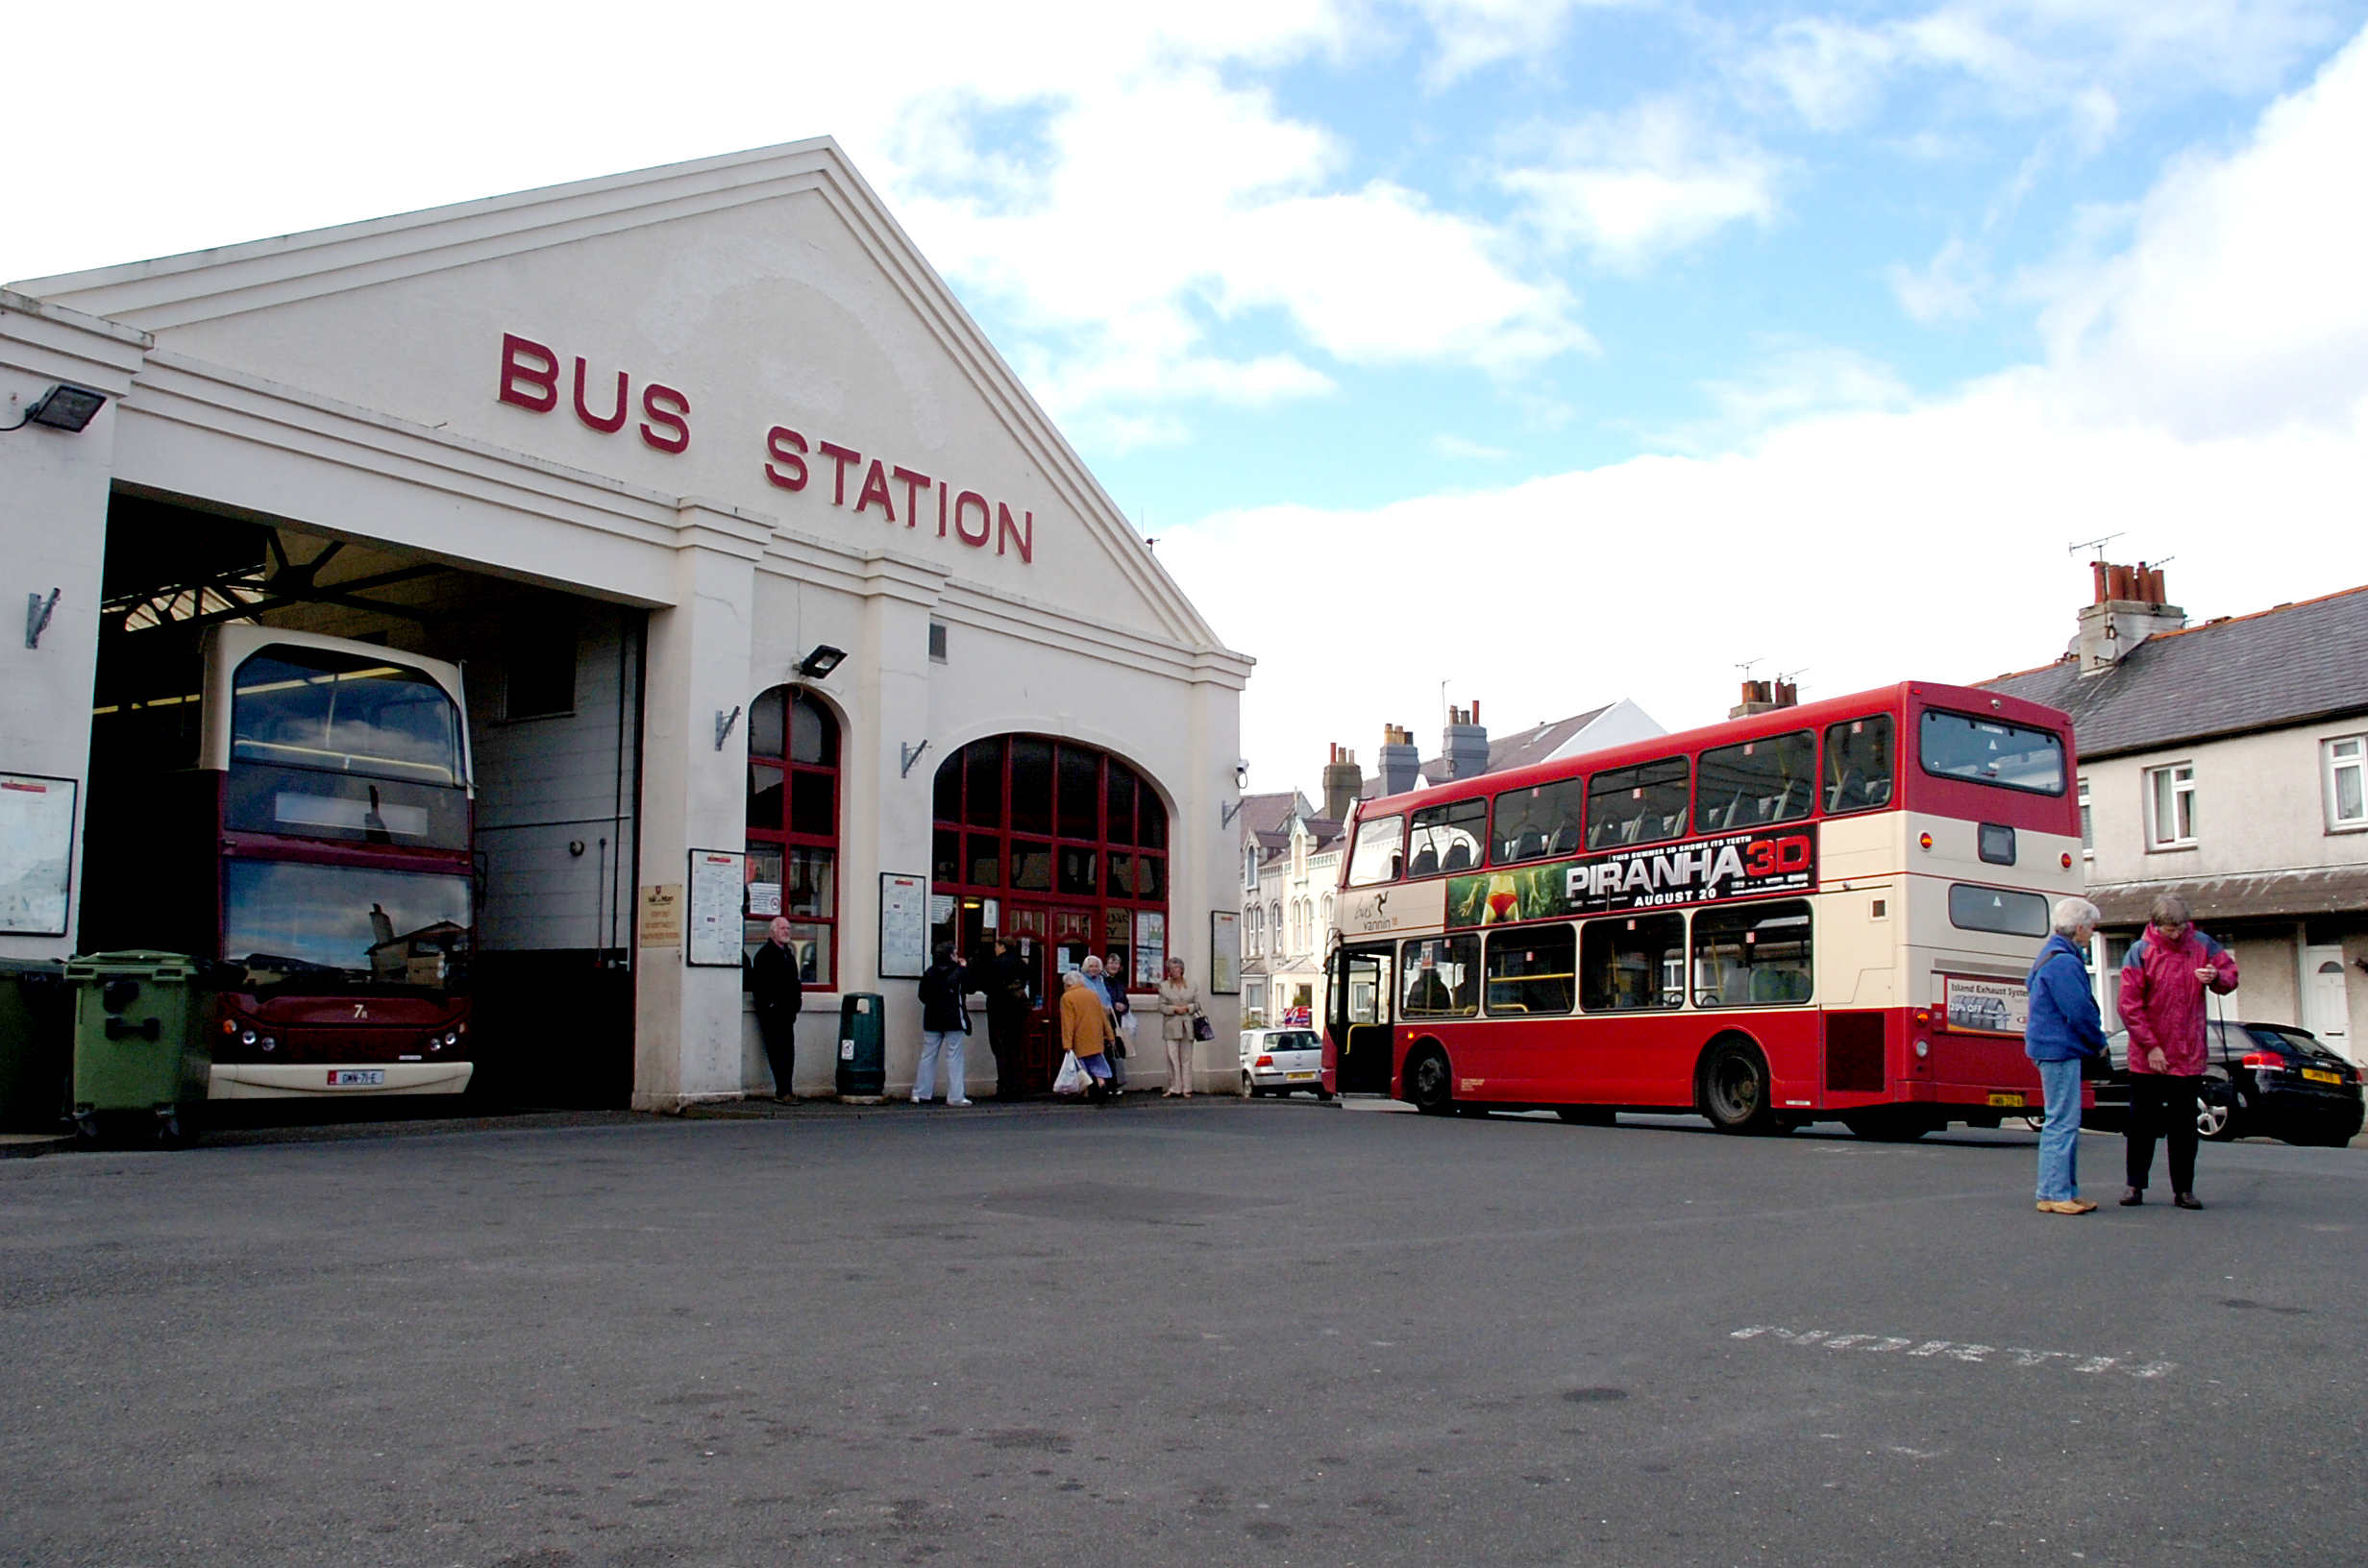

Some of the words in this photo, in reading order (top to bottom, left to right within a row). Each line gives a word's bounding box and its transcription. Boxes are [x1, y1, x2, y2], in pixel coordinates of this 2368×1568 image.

[498, 332, 691, 454] BUS
[764, 426, 1033, 564] STATION
[1612, 853, 1630, 862] THIS
[1631, 847, 1665, 860] SUMMER
[1679, 841, 1708, 852] SHOWS
[1711, 839, 1724, 847] ITS
[1726, 835, 1752, 845] TEETH
[1566, 845, 1746, 898] PIRANHA
[1745, 834, 1812, 876] 3D
[1634, 890, 1693, 907] AUGUST
[1698, 888, 1717, 900] 20
[1951, 983, 1974, 992] Island
[1976, 985, 2007, 995] Exhaust
